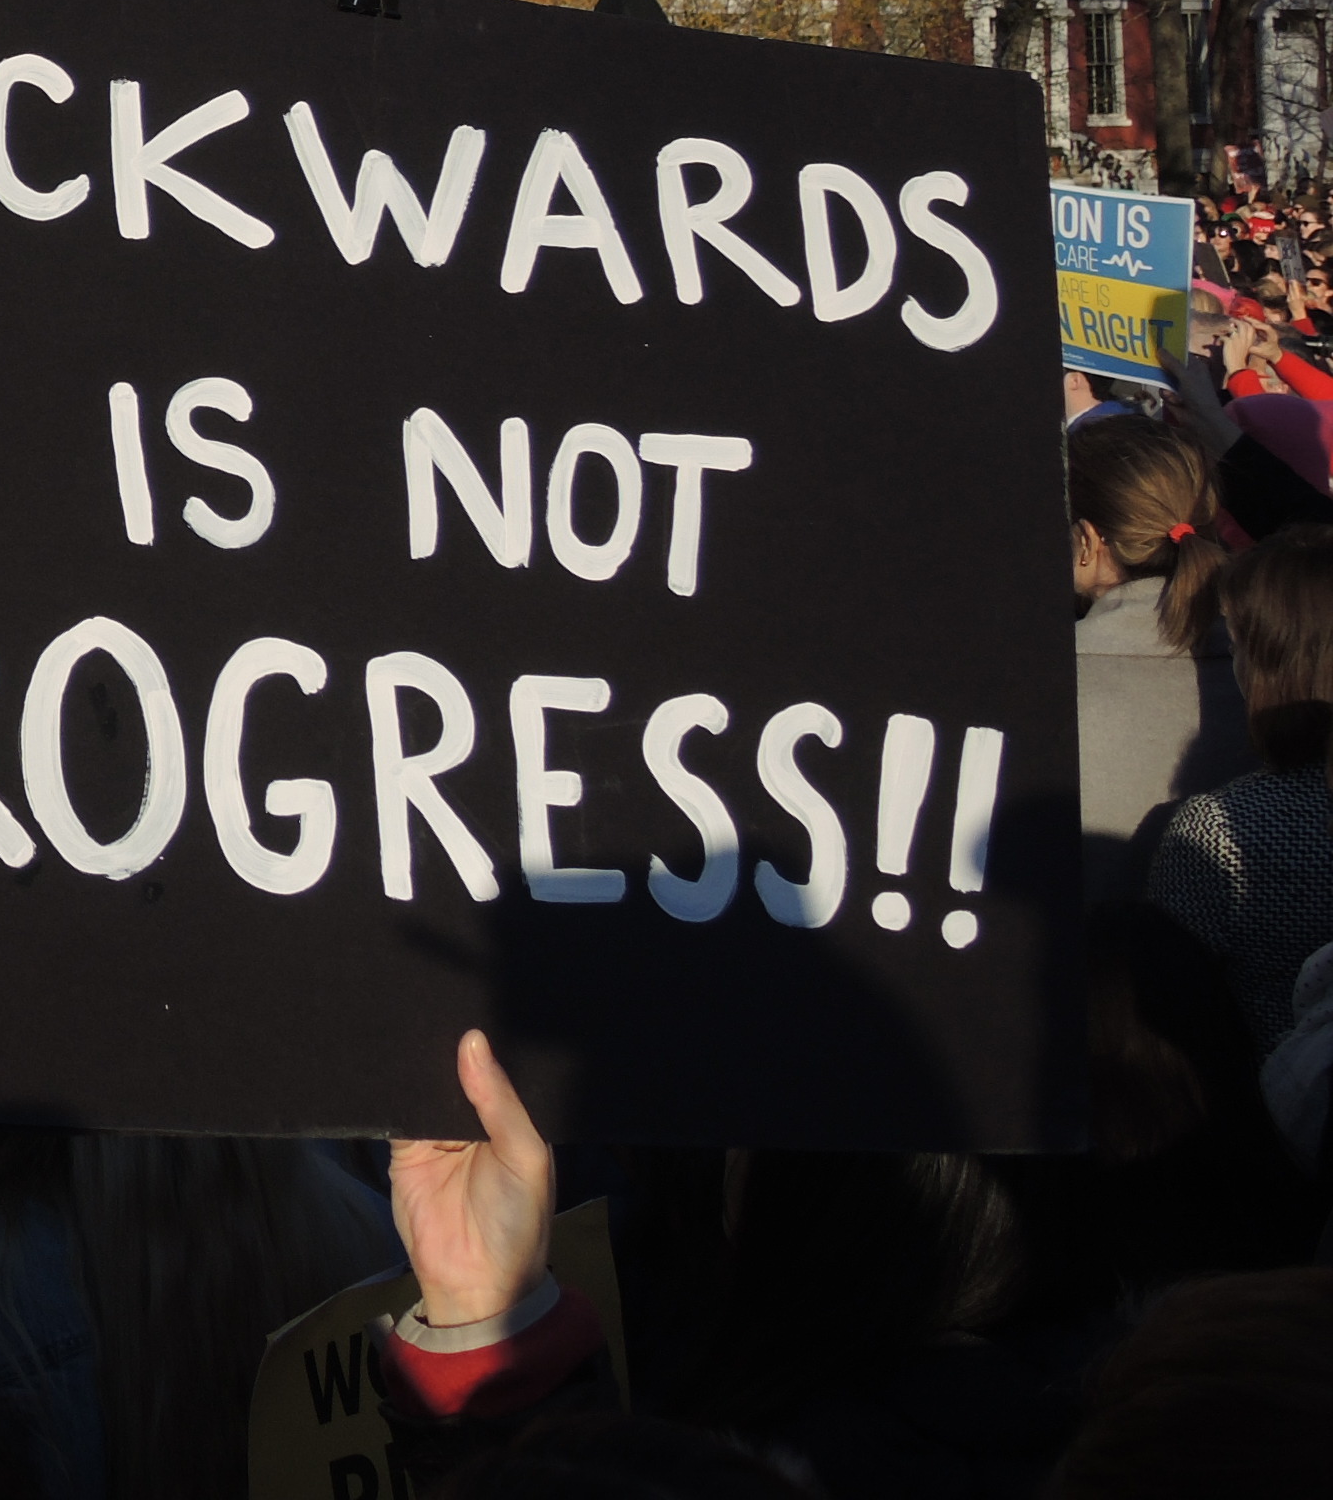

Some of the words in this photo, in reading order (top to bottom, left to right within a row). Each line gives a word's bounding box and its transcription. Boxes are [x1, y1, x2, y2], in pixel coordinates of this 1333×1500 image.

[1117, 203, 1151, 249] IS
[1096, 284, 1110, 308] IS
[1080, 307, 1174, 359] RIGHT
[109, 377, 276, 549] IS
[403, 407, 753, 597] NOT
